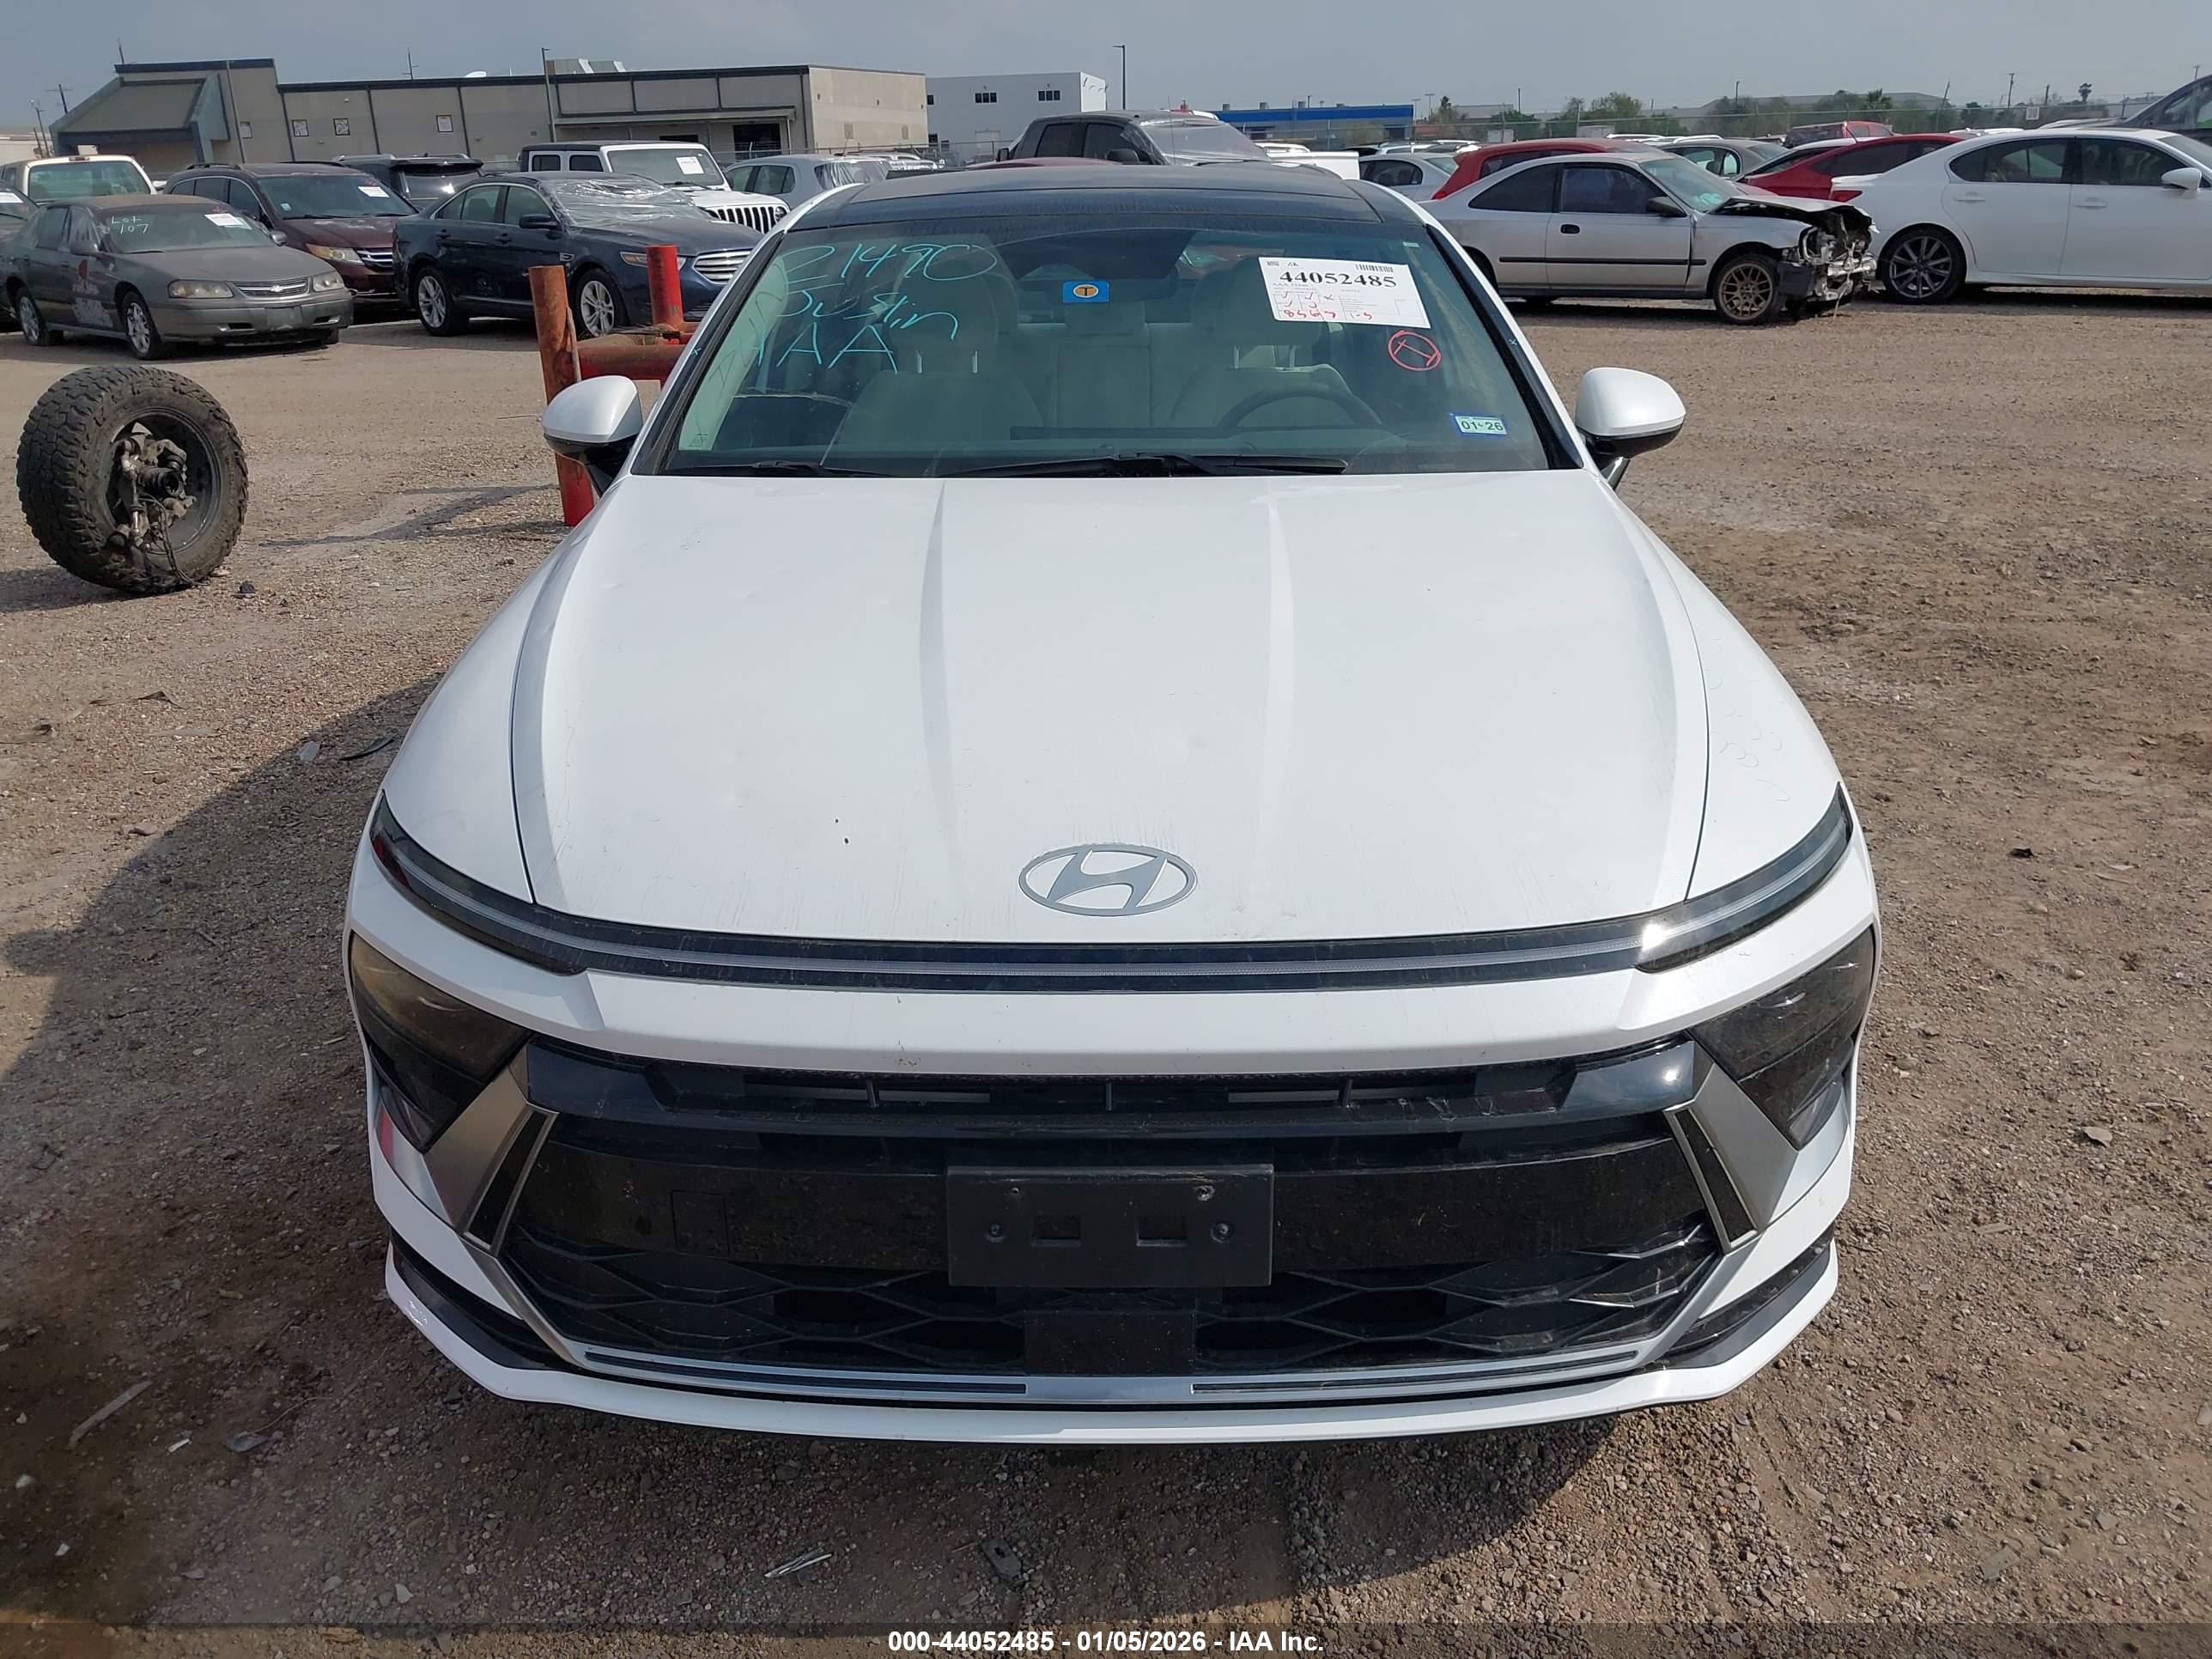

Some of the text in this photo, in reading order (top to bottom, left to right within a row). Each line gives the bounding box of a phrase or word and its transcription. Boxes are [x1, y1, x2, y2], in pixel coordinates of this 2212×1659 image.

[111, 215, 143, 224] Lot
[119, 223, 149, 234] 107
[1279, 270, 1398, 289] 44052485
